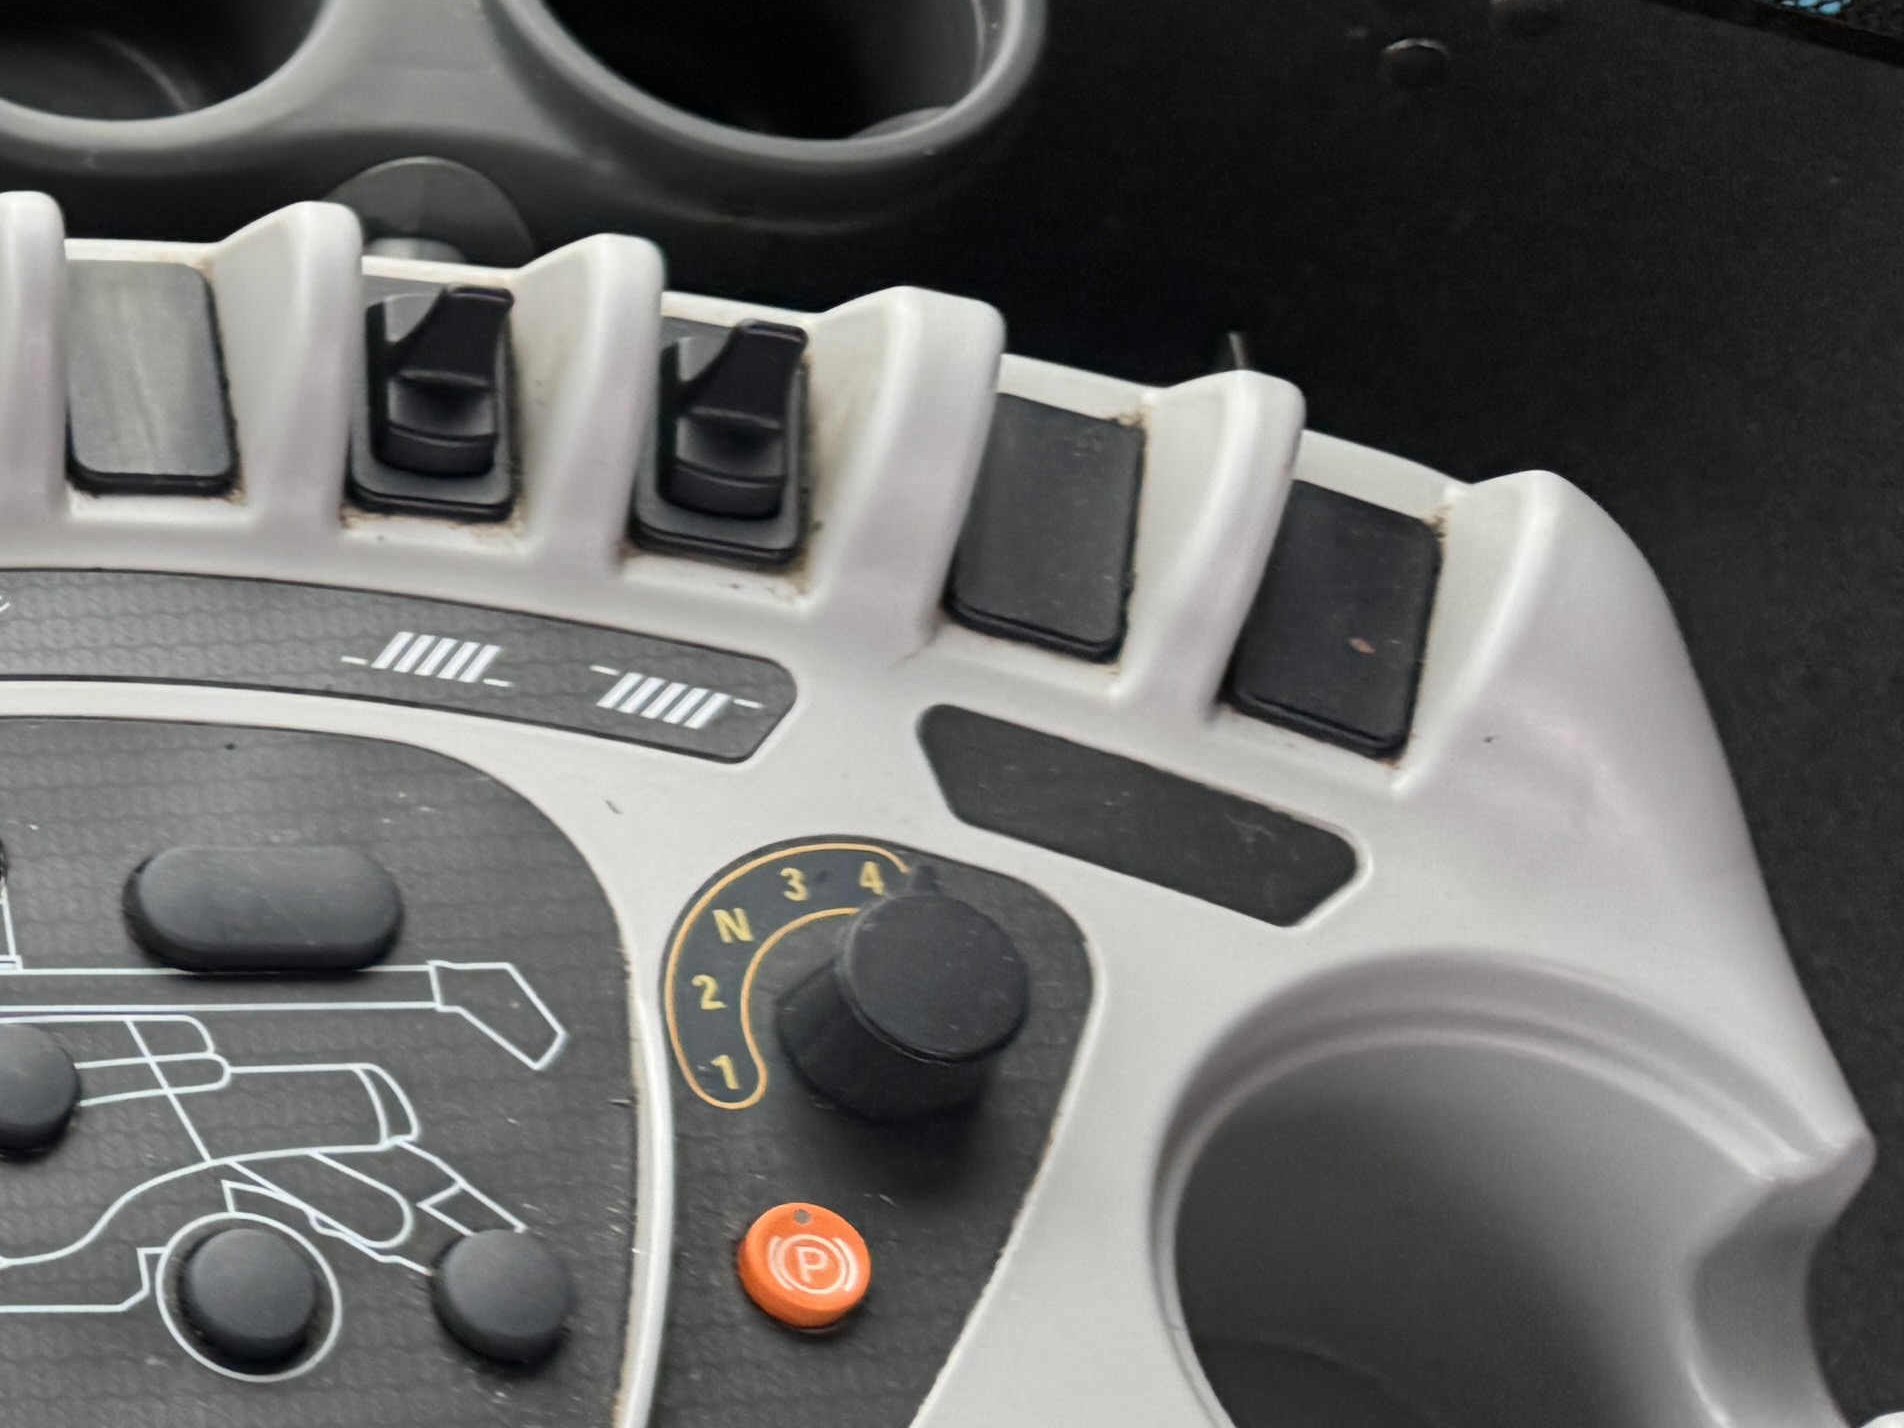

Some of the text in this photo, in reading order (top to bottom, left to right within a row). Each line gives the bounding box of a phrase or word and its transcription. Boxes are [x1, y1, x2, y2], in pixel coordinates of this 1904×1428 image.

[692, 861, 886, 1090] 1 2 N 3 4
[795, 1246, 829, 1284] P
